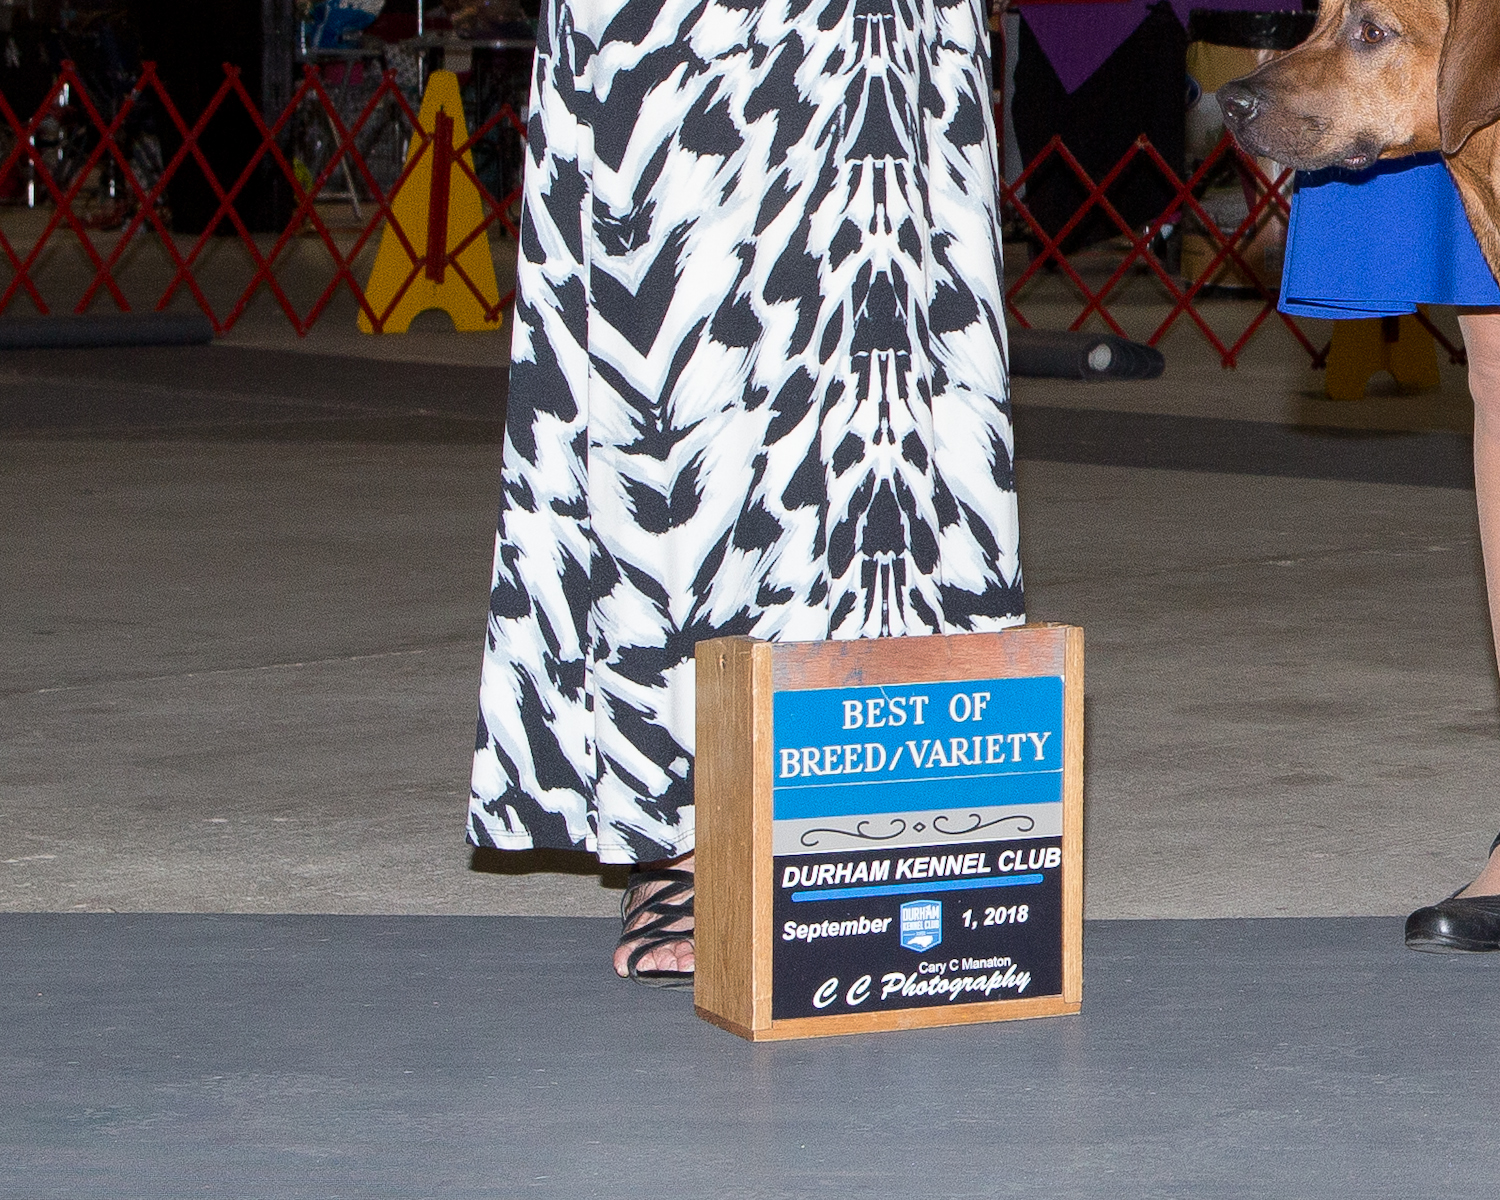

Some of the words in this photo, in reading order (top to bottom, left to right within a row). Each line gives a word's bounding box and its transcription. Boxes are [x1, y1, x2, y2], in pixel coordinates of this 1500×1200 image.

[842, 695, 929, 730] BEST
[949, 692, 991, 723] OF
[779, 731, 1051, 779] BREED/VARIETY
[781, 859, 890, 889] DURHAM
[895, 854, 992, 880] KENNEL
[998, 847, 1061, 872] CLUB
[782, 915, 892, 942] September
[961, 909, 978, 930] 1,
[983, 904, 1029, 926] 2018
[902, 904, 940, 921] DURHAM
[919, 960, 946, 976] Cary
[949, 959, 959, 971] C
[962, 956, 1011, 971] Manaton
[812, 977, 839, 1009] C
[845, 974, 872, 1006] C
[881, 964, 1032, 1001] Photography
